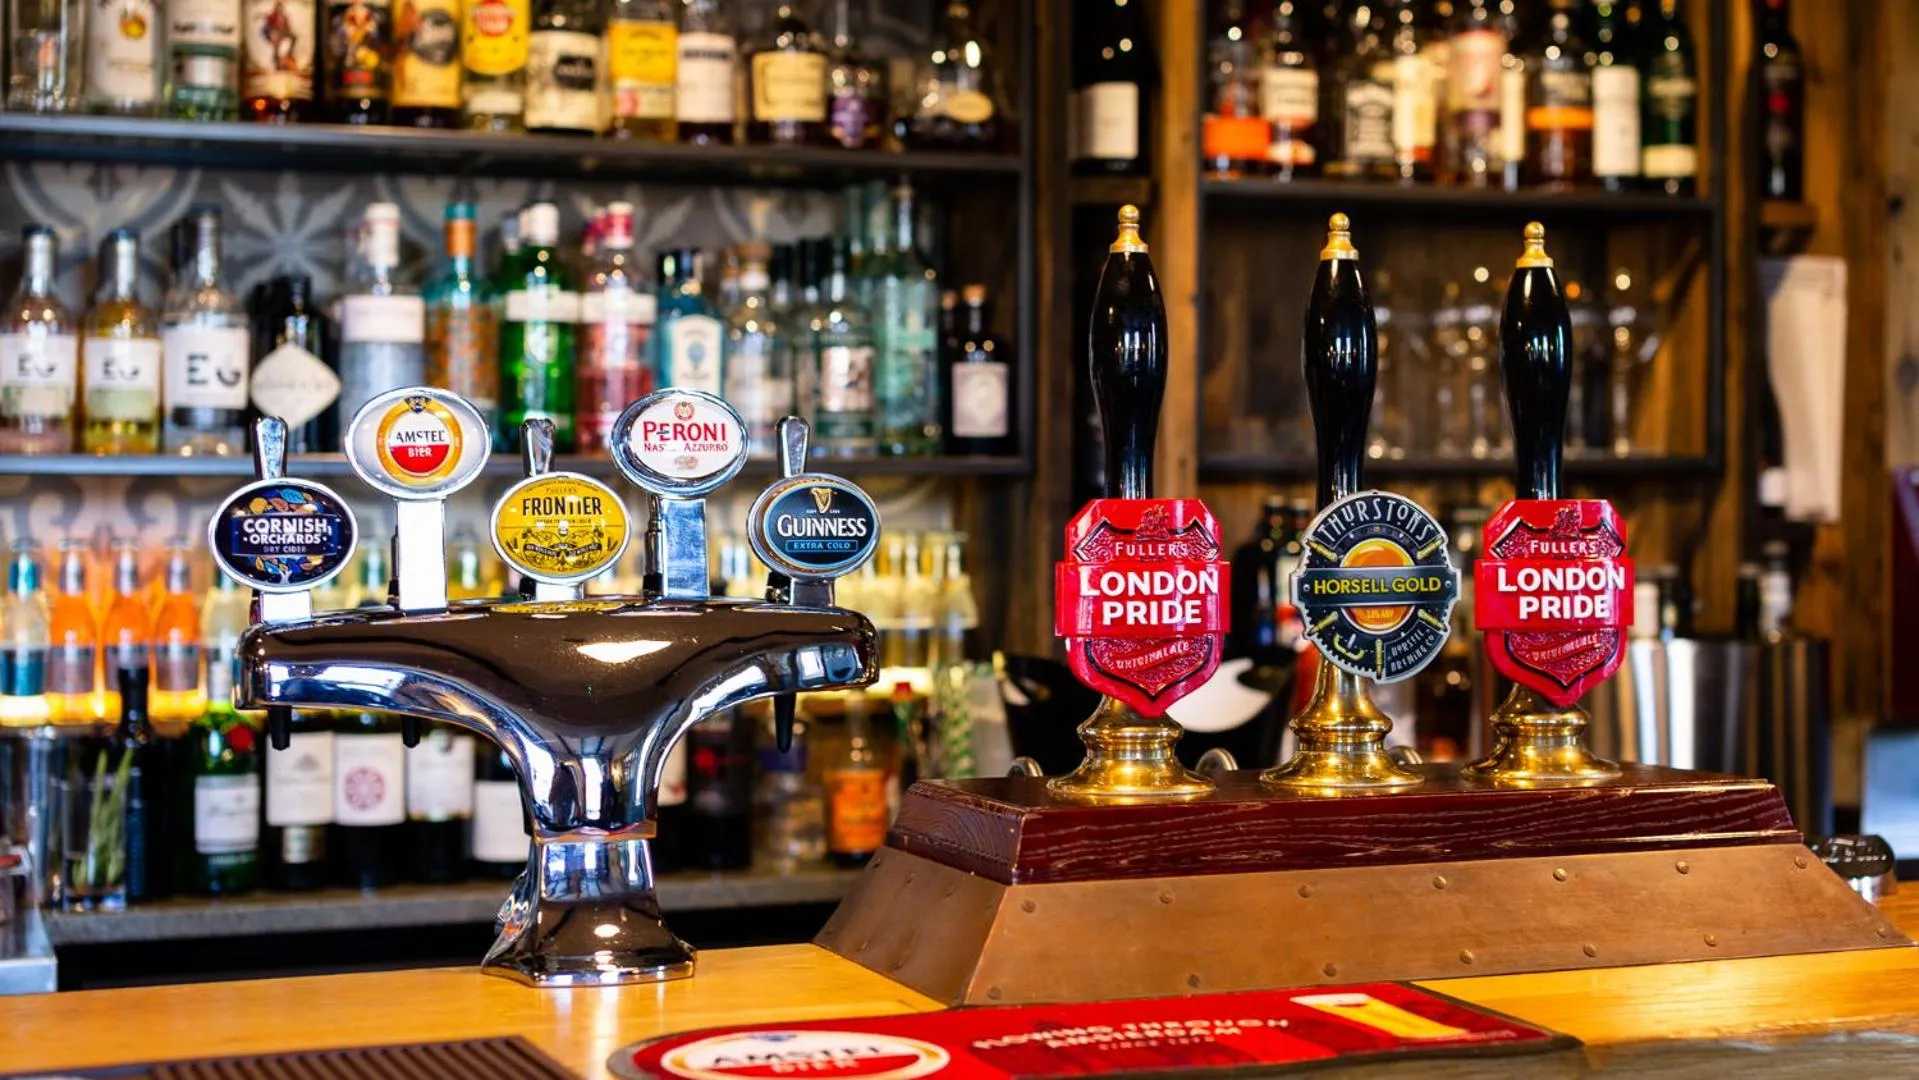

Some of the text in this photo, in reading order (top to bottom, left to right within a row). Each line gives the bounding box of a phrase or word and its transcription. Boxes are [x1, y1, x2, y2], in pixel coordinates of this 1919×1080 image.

[395, 430, 446, 444] AMSTEL
[642, 420, 727, 442] PERONI
[407, 447, 432, 458] BIER
[242, 518, 328, 534] CORNISH
[777, 514, 867, 537] GUINNESS
[249, 533, 321, 545] ORCHARDS
[793, 541, 851, 550] EXTRA COLD
[263, 545, 307, 554] DRY CIDER
[1079, 566, 1219, 597] LONDON
[1313, 576, 1442, 595] HORSELL GOLD
[1497, 566, 1626, 593] LONDON
[1102, 599, 1202, 626] PRIDE
[1519, 594, 1611, 620] PRIDE
